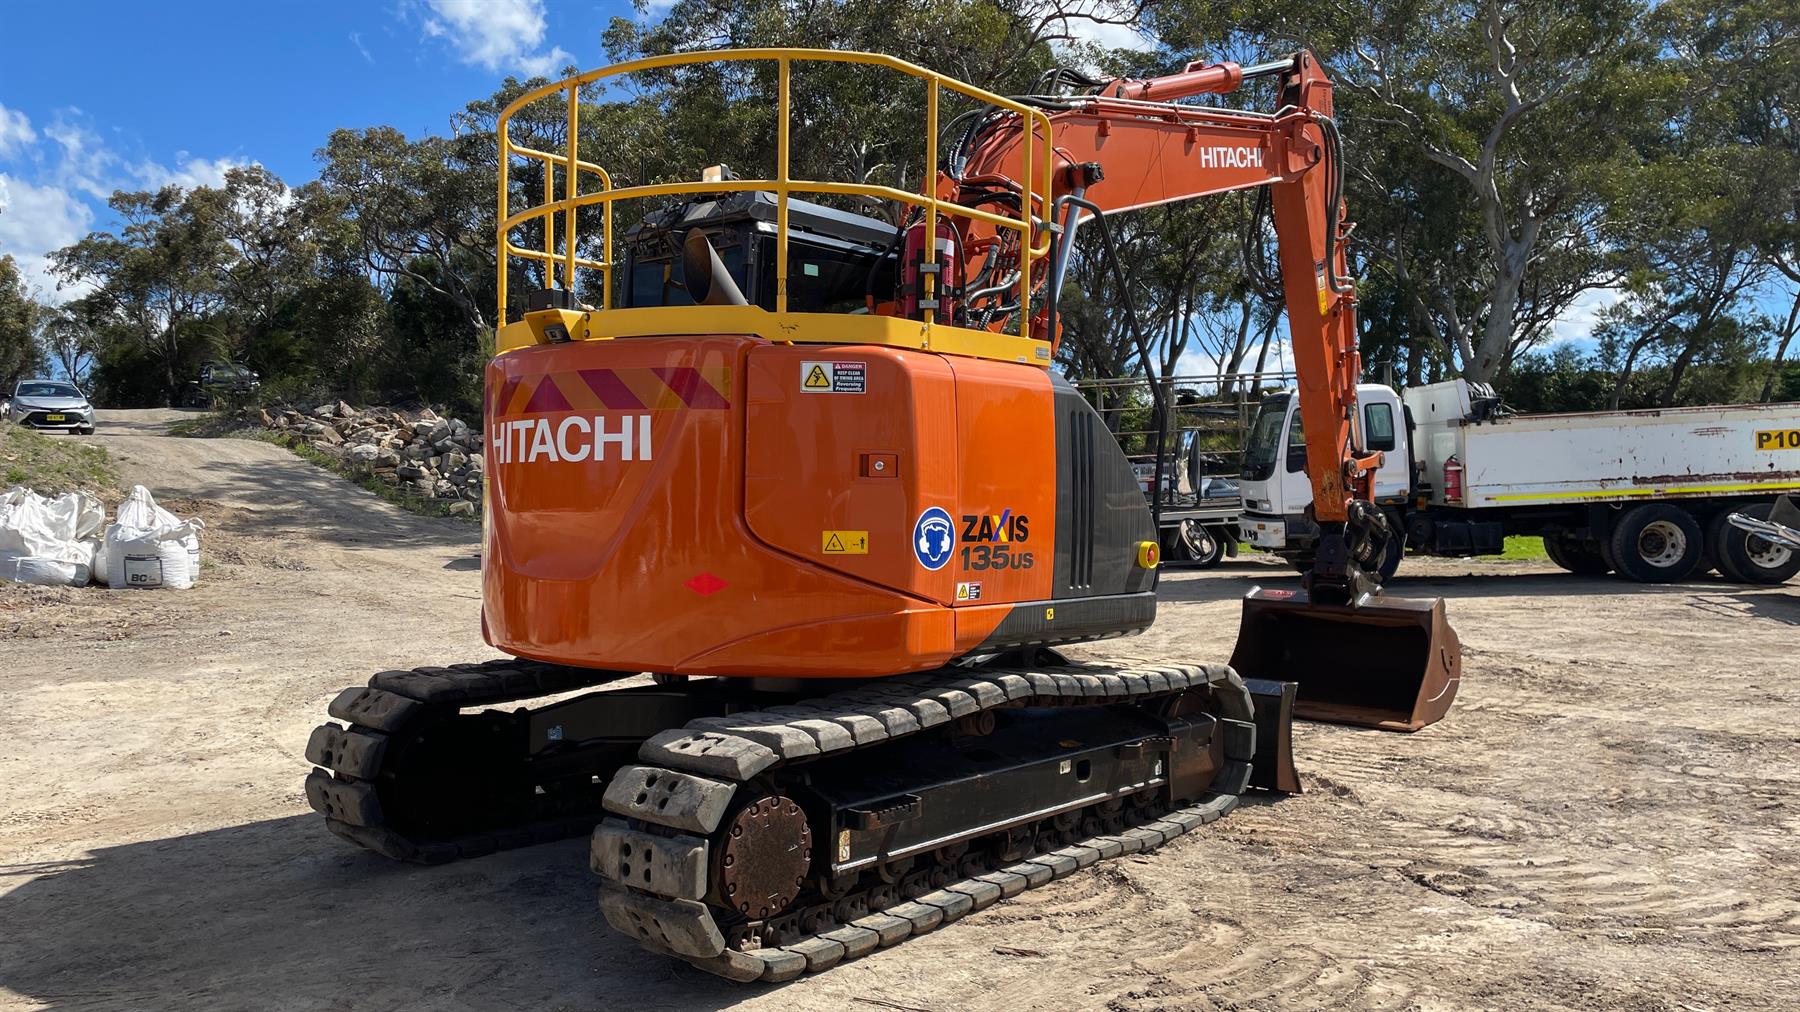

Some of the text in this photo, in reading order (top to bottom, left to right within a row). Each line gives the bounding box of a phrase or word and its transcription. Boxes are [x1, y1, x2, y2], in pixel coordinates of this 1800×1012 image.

[1200, 147, 1262, 168] HITACHI
[492, 415, 652, 464] HITACHI
[961, 509, 1029, 542] ZAXIS
[131, 574, 148, 582] BC
